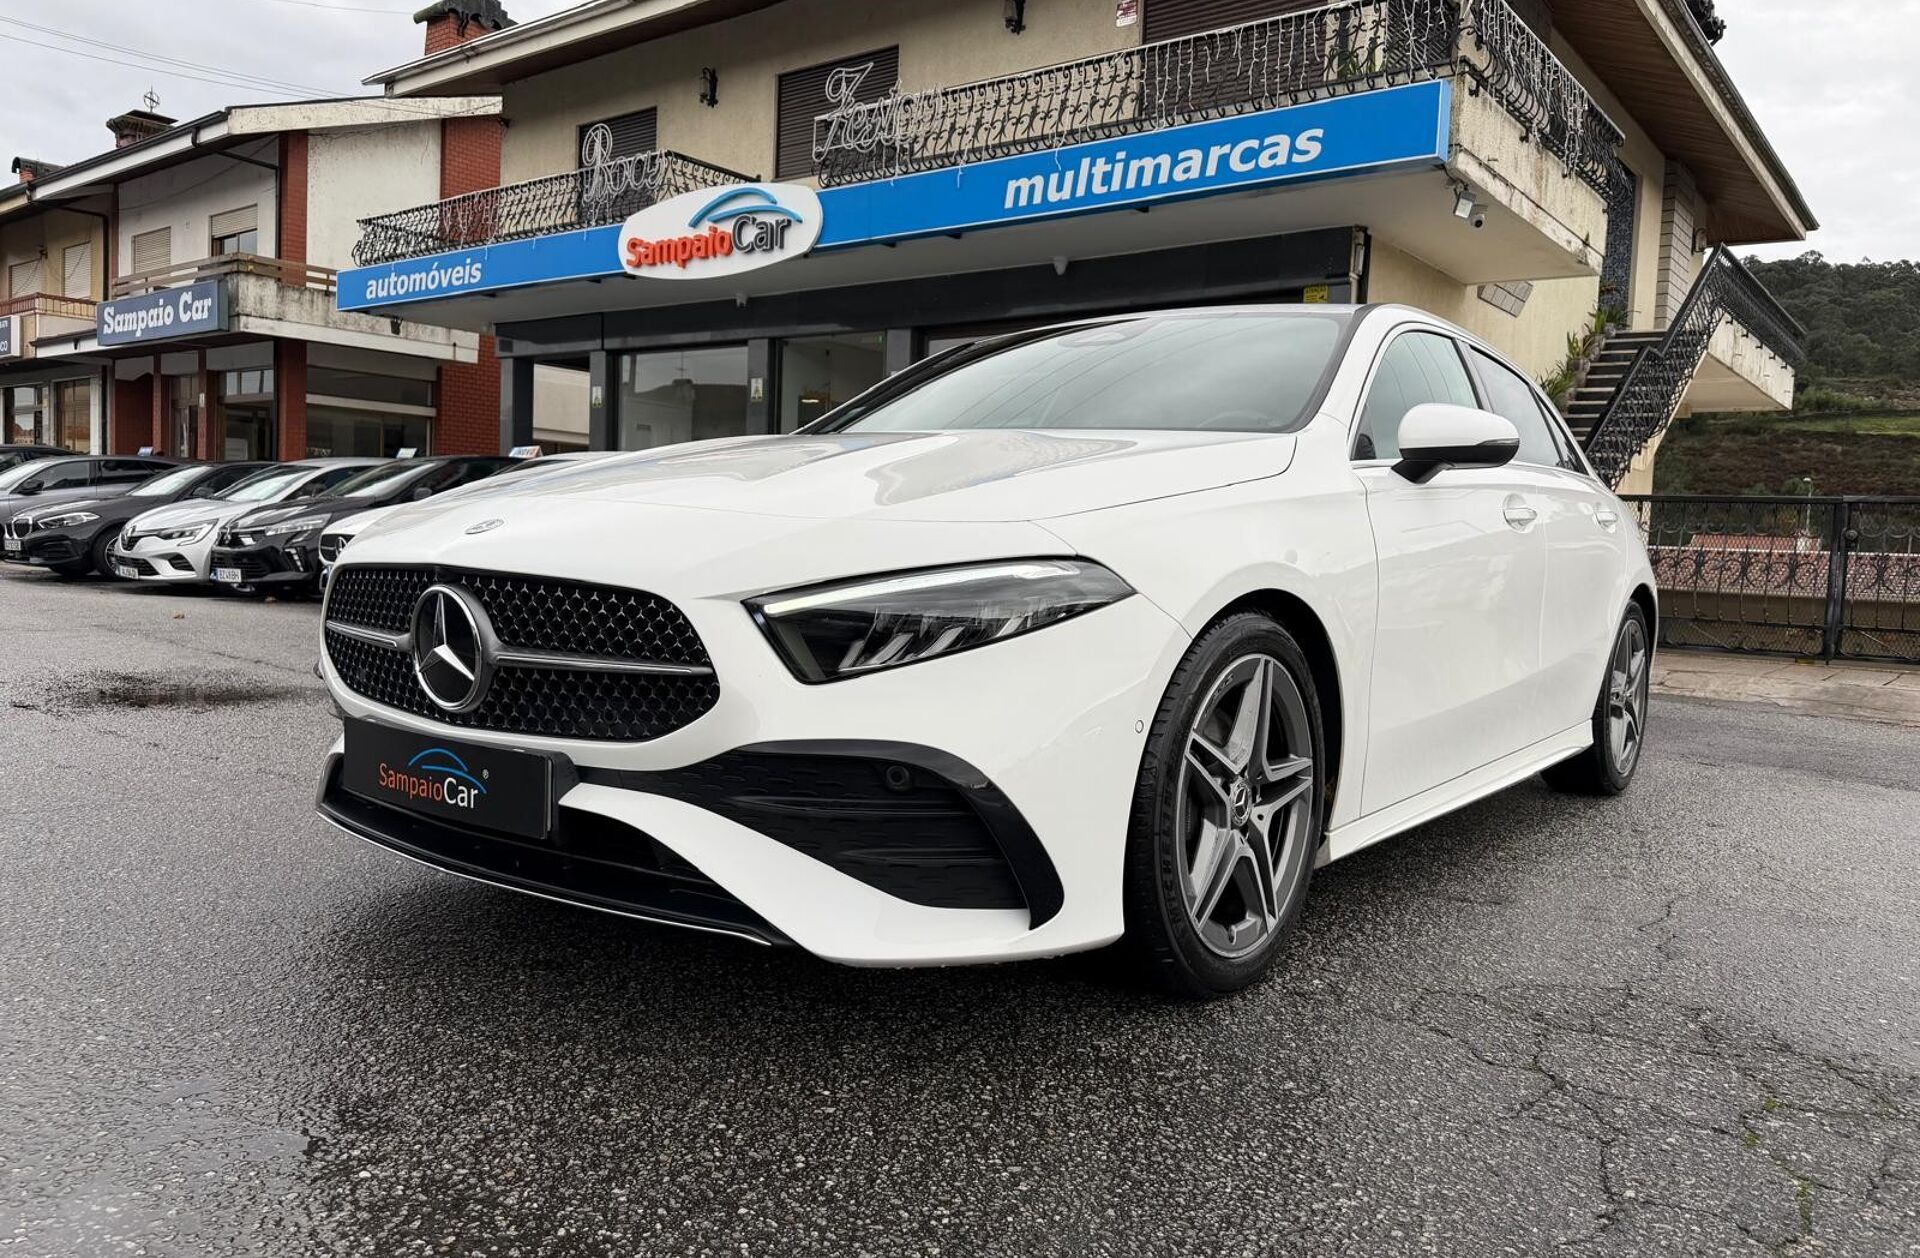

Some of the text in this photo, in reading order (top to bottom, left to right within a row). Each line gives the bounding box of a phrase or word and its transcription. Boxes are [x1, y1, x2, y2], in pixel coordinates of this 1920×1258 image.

[1004, 127, 1324, 209] multimarcas
[626, 214, 792, 269] SampaioCar
[365, 258, 482, 299] automóveis
[103, 291, 212, 337] Sampaio Car
[378, 763, 479, 809] SampaioCar
